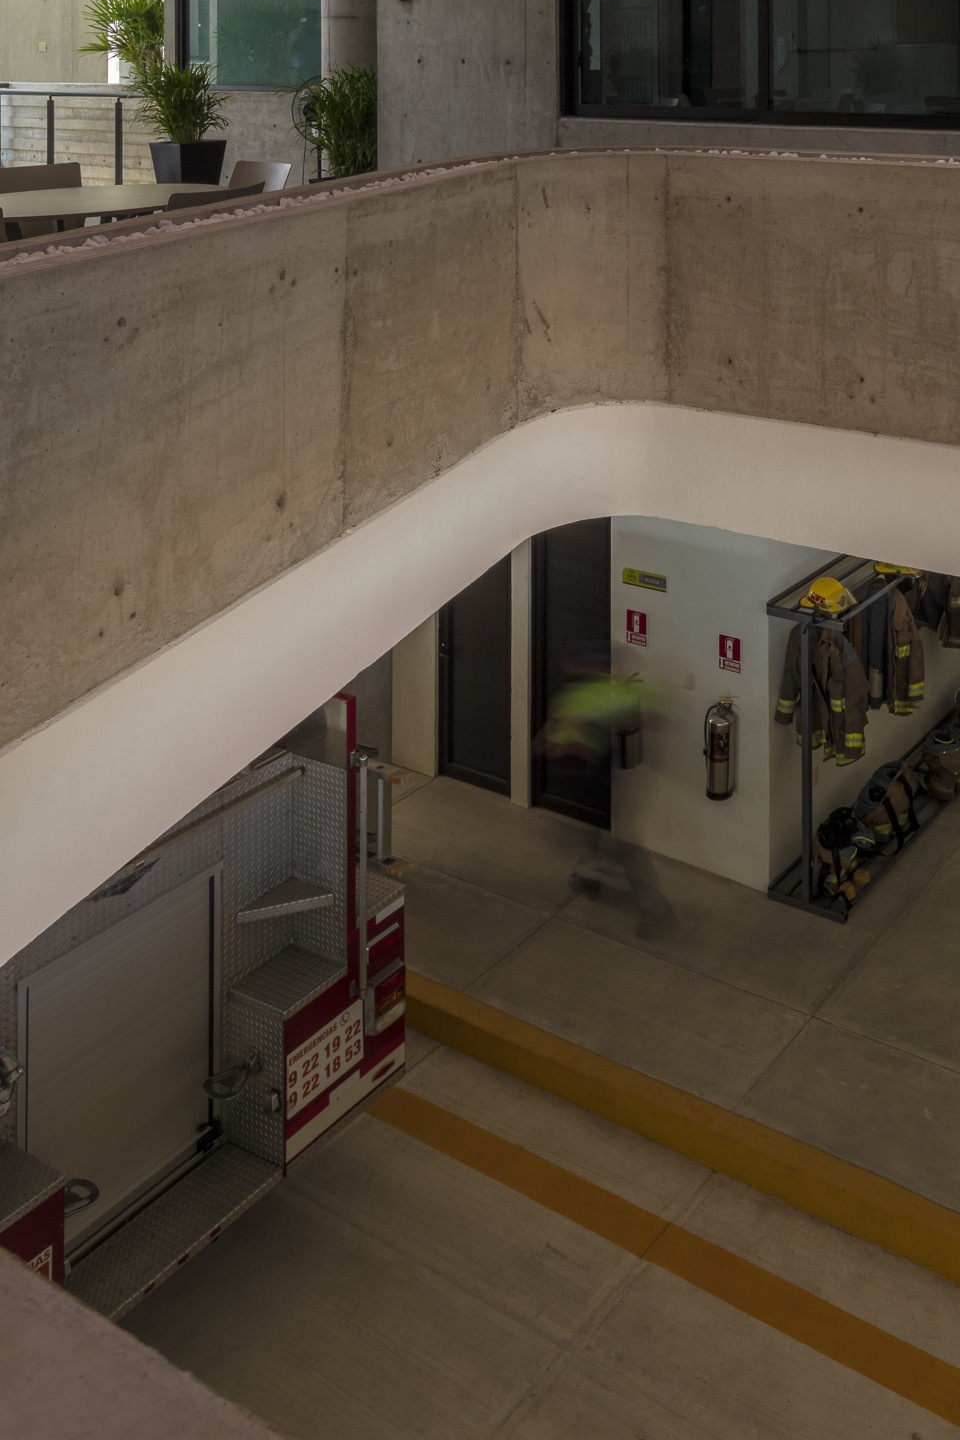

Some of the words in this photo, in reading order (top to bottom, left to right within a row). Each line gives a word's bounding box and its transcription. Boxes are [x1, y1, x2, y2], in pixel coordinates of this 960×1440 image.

[288, 1070, 298, 1089] 9
[302, 1052, 320, 1079] 22
[324, 1035, 341, 1059] 19
[345, 1018, 361, 1044] 22
[288, 1091, 298, 1110] 9
[302, 1072, 320, 1100] 22
[324, 1055, 341, 1079] 18
[345, 1038, 361, 1063] 53
[289, 1022, 338, 1067] EMERGENCIAS
